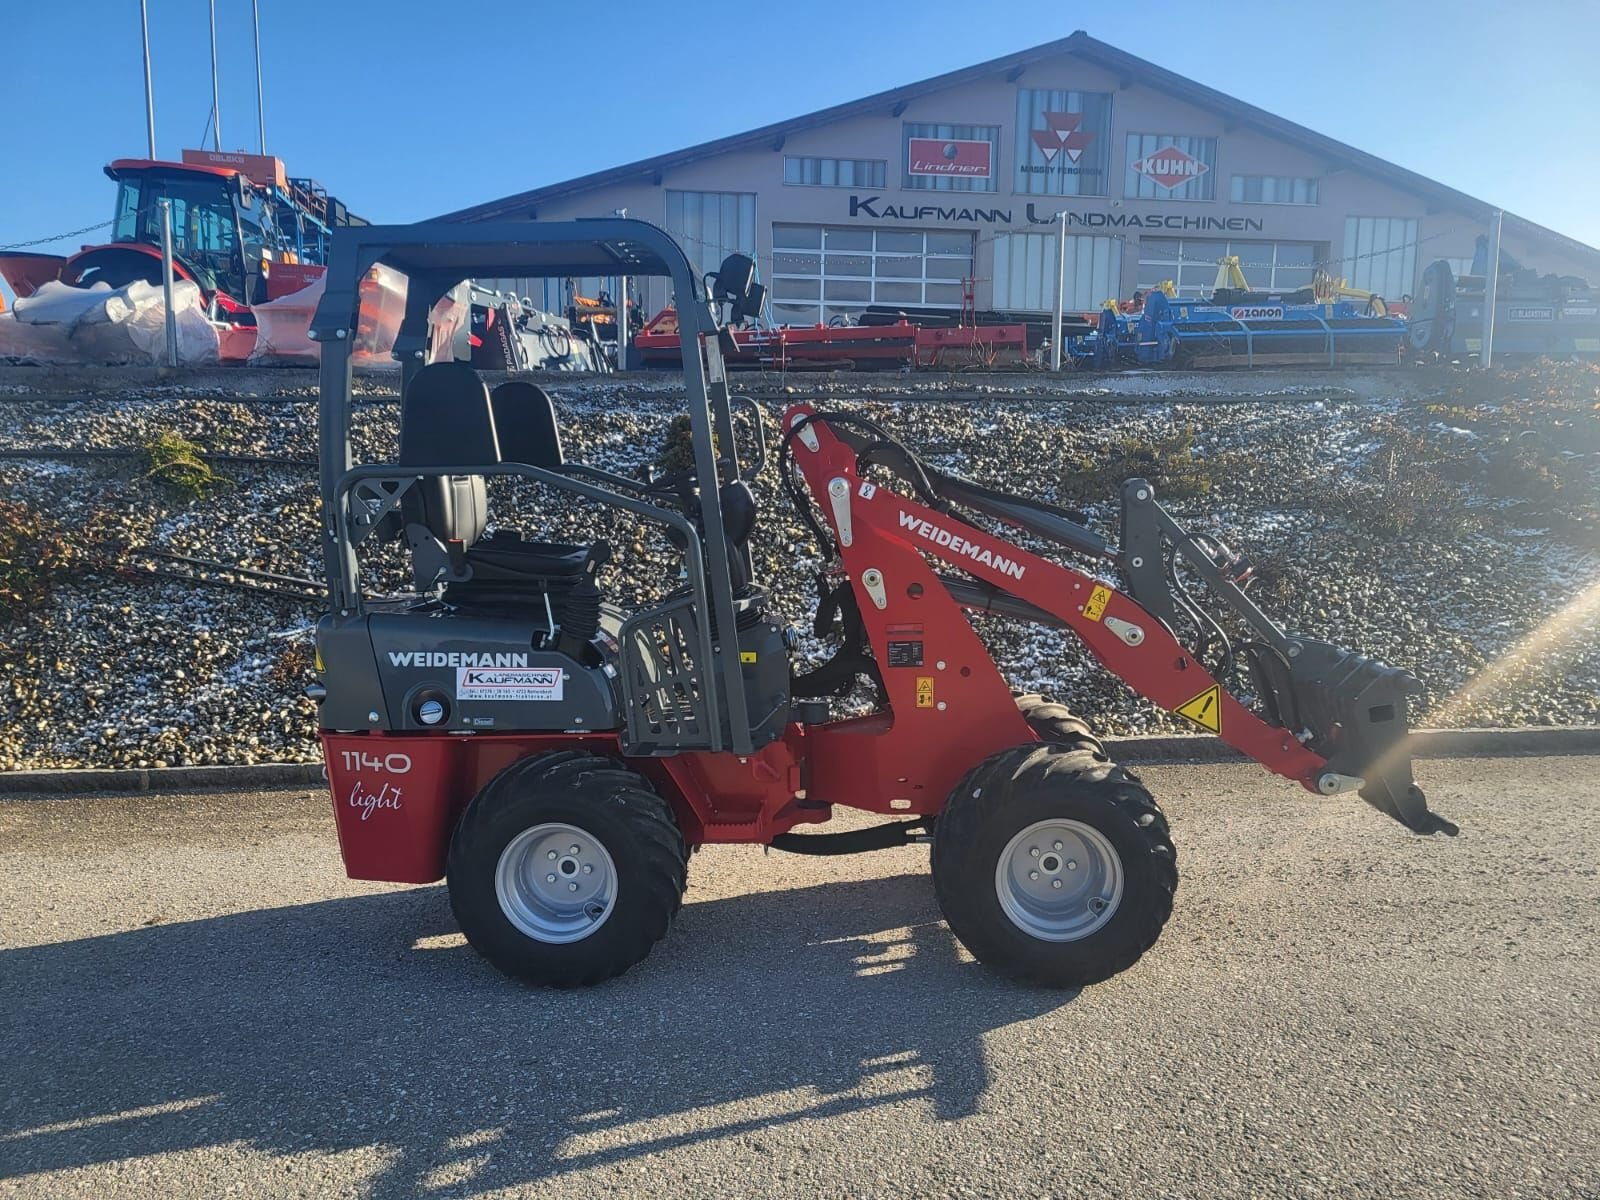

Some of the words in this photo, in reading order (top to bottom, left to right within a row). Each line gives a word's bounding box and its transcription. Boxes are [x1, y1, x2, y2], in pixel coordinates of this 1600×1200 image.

[913, 160, 987, 173] Lindner
[1020, 165, 1055, 175] MASSEY
[1141, 158, 1199, 176] KUHN
[849, 196, 1012, 224] KAUFMANN
[1244, 307, 1282, 318] zanon
[899, 510, 1026, 580] WEIDEMANN
[388, 652, 528, 667] WEIDEMANN
[469, 673, 553, 684] KAUFMANN
[341, 751, 412, 774] 1140
[350, 781, 403, 820] light
